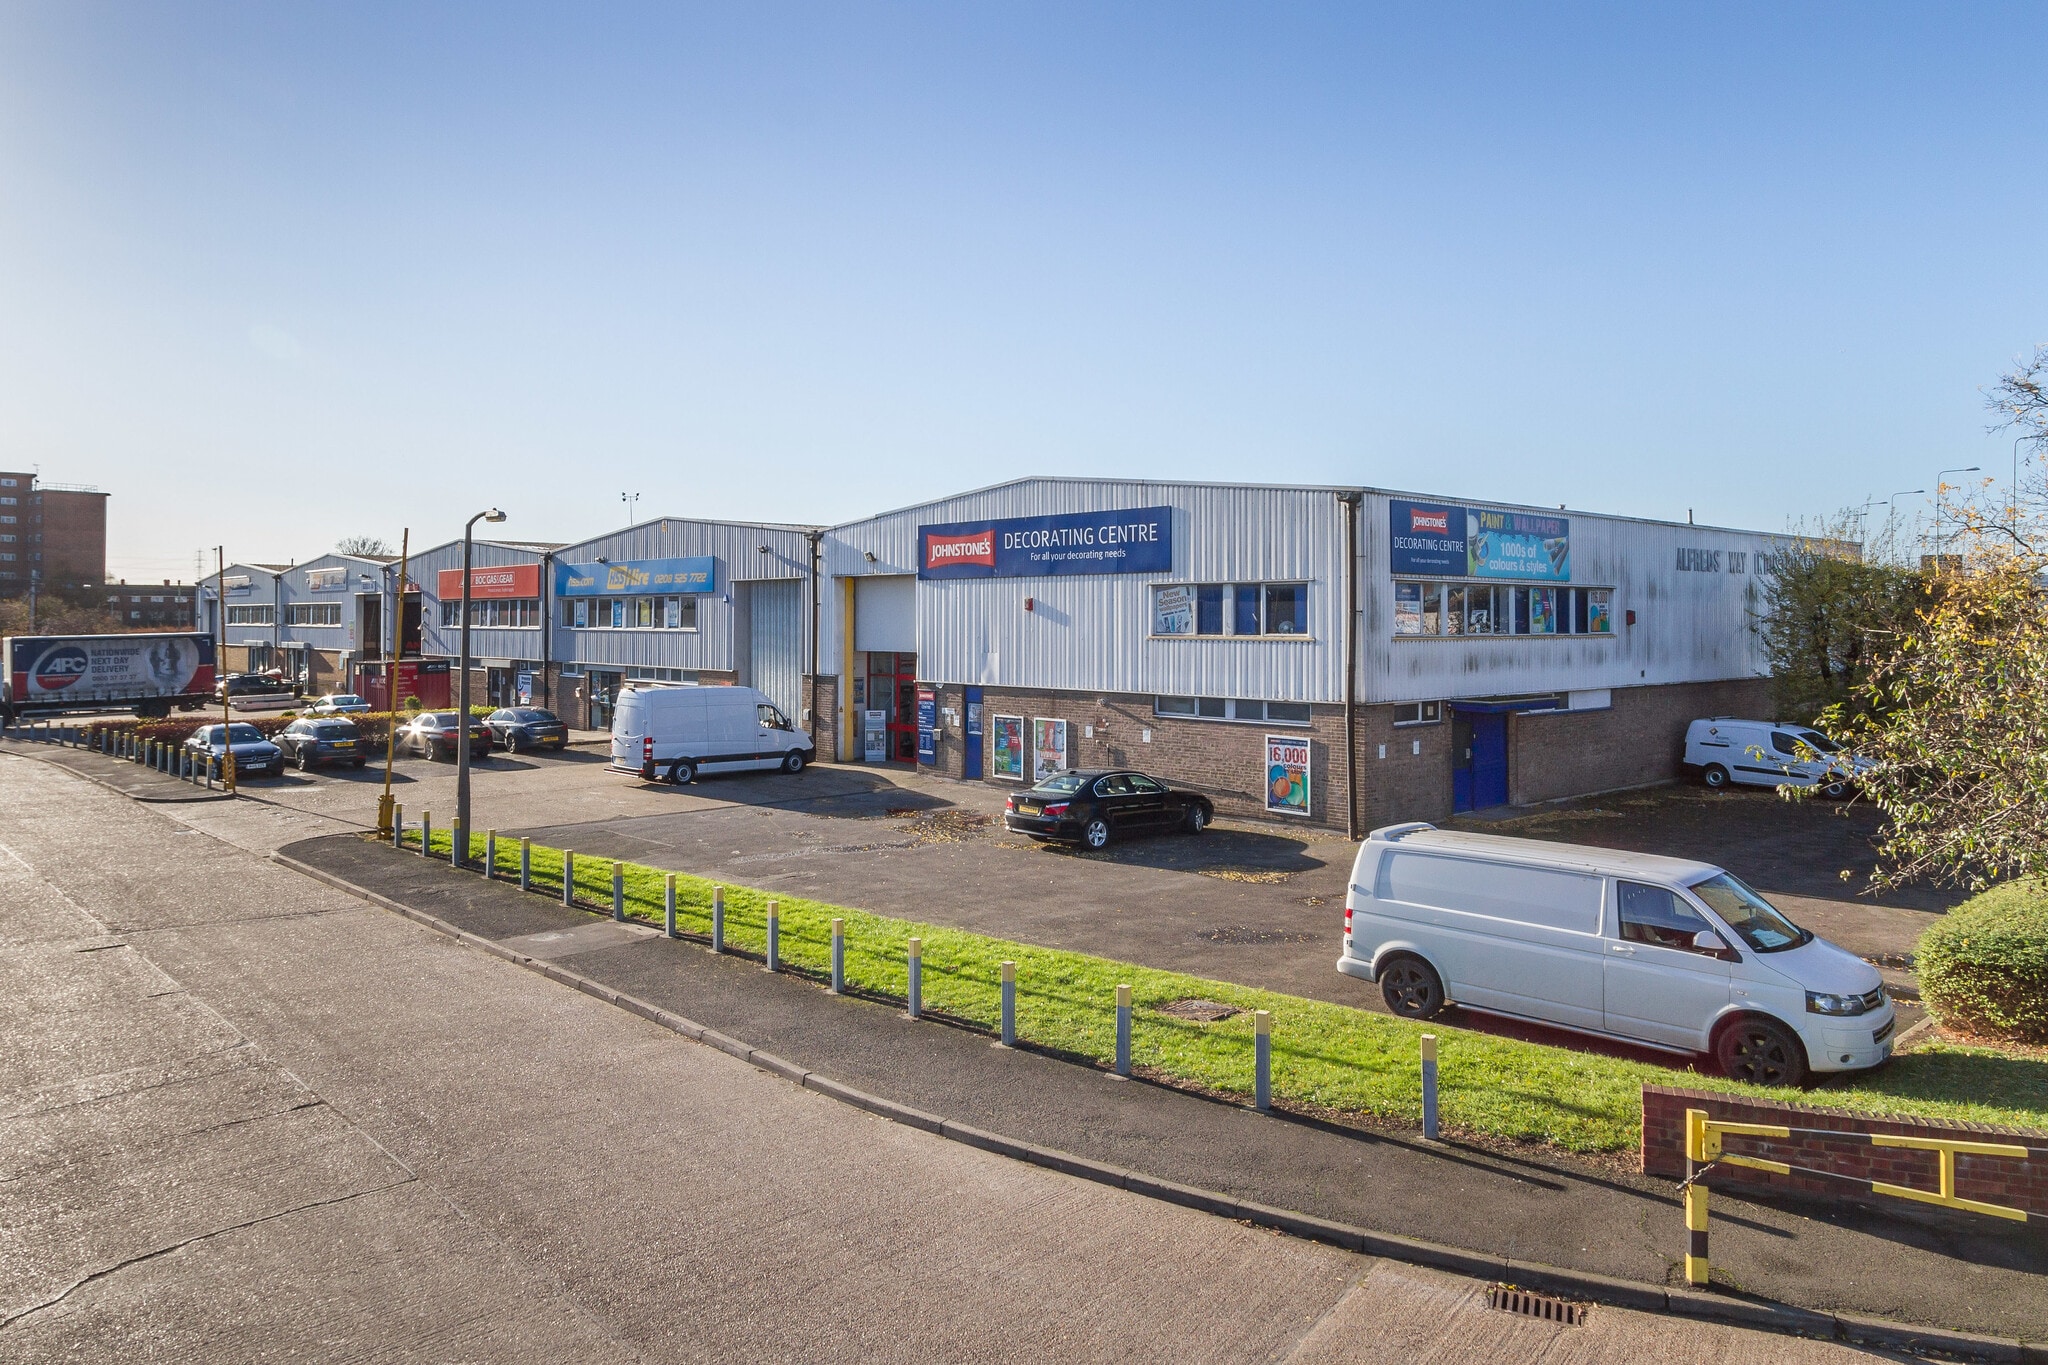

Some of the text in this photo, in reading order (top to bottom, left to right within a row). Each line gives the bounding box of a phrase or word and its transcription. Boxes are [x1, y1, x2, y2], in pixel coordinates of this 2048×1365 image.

[1413, 516, 1446, 528] JOHNSTONE'S
[1480, 512, 1560, 535] PAINT & WALLPAPER
[1004, 523, 1158, 550] DECORATING CENTRE
[931, 538, 991, 562] JOHNSTONE'S
[1394, 537, 1464, 553] DECORATING CENTRE
[1501, 542, 1537, 558] 1000s of
[1030, 548, 1126, 562] For all your decorating needs
[1489, 559, 1548, 574] colours & styles
[1728, 551, 1747, 574] WAY
[475, 576, 486, 585] BOC
[487, 575, 497, 584] GAS
[500, 574, 513, 584] GEAR
[626, 567, 649, 586] Hire
[1158, 596, 1187, 607] Season
[1162, 590, 1180, 599] New
[91, 648, 140, 657] NATIONWIDE
[45, 657, 86, 673] APC
[91, 657, 111, 665] NEXT
[91, 665, 129, 673] DELIVERY
[1283, 763, 1307, 771] colours
